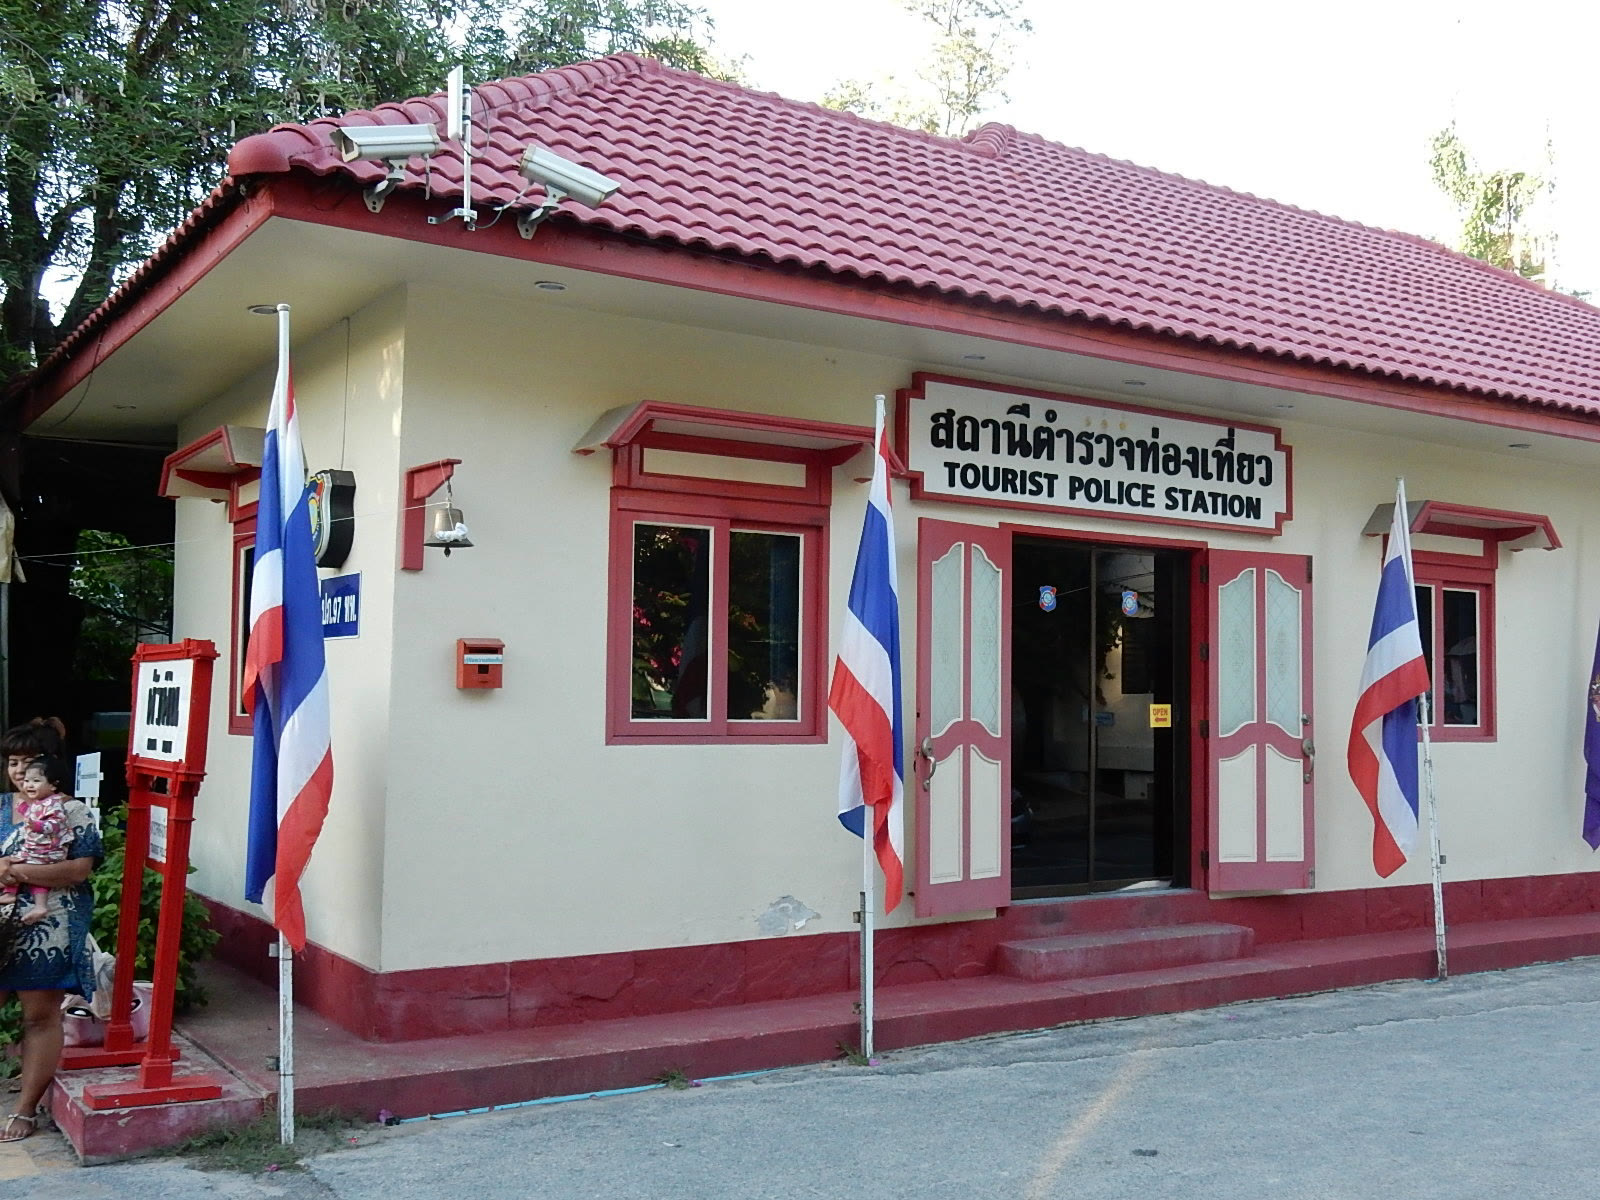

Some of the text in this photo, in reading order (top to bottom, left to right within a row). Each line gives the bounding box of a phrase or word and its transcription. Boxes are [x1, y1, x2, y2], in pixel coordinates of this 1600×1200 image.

[930, 402, 1273, 487] สถานีตำรวจท่องเที่ยว
[943, 461, 1262, 520] TOURIST POLICE STATION
[1152, 707, 1169, 717] OPEN
